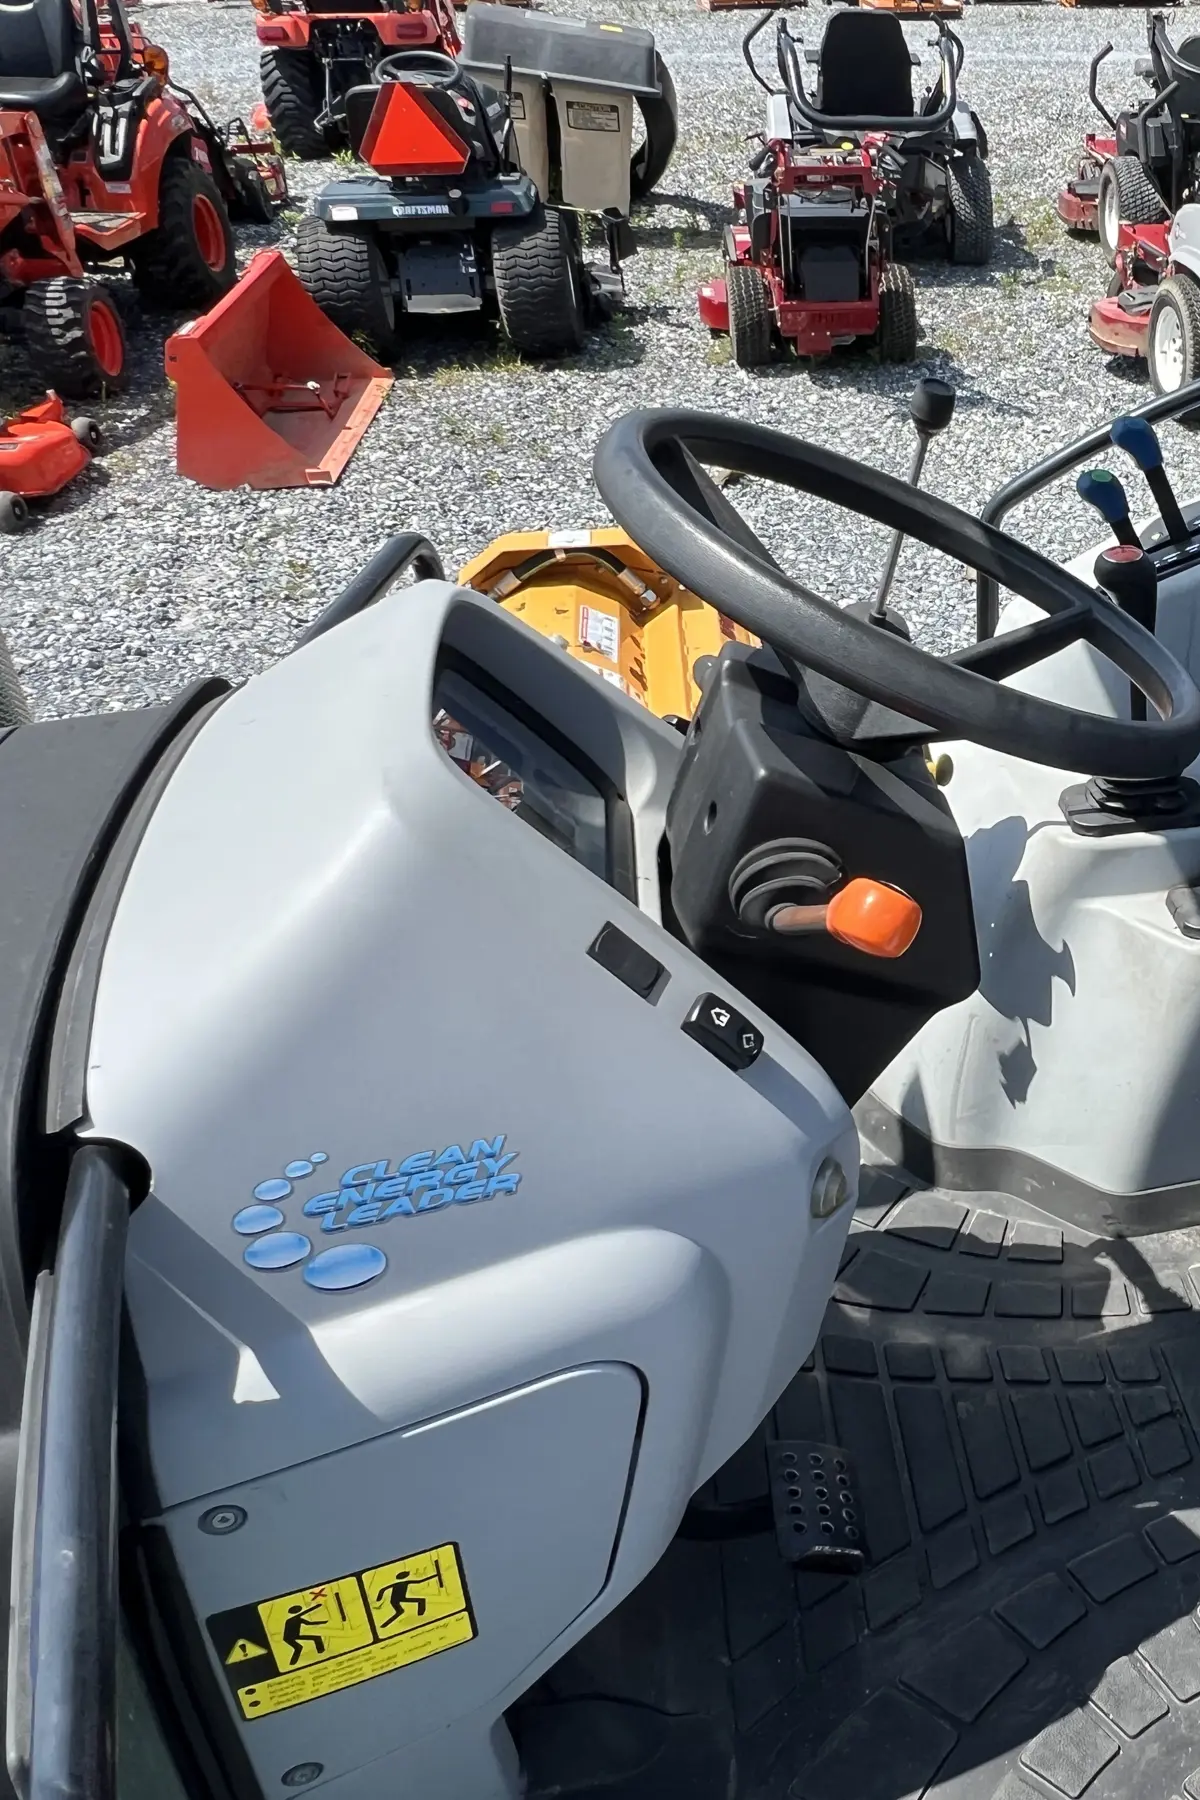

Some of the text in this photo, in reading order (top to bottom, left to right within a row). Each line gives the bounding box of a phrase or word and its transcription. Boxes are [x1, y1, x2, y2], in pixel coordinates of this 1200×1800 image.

[392, 204, 450, 217] CRAFTSMAN
[302, 1151, 520, 1217] ENERGY
[339, 1133, 507, 1189] CLEAN
[319, 1172, 522, 1235] LEADER
